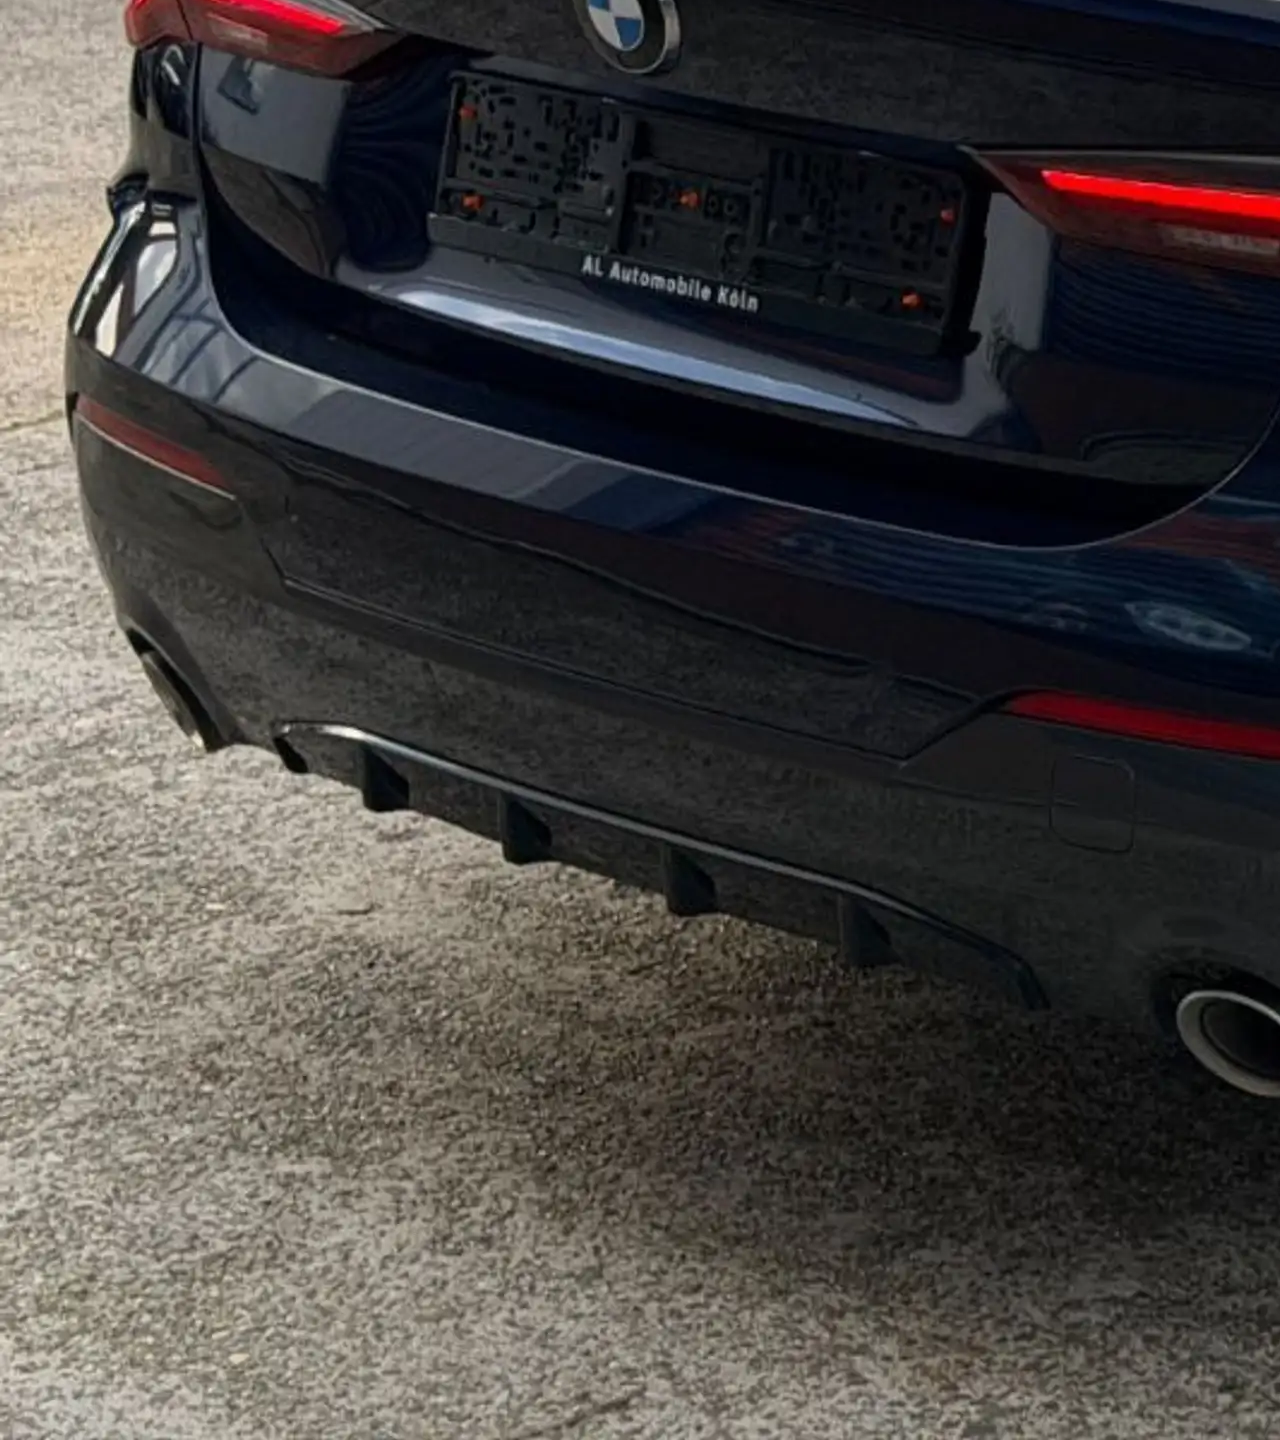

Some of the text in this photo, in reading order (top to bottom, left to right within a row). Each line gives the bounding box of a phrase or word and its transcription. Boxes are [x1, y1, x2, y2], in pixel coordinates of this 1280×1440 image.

[581, 254, 759, 312] AL Automobile Köln
